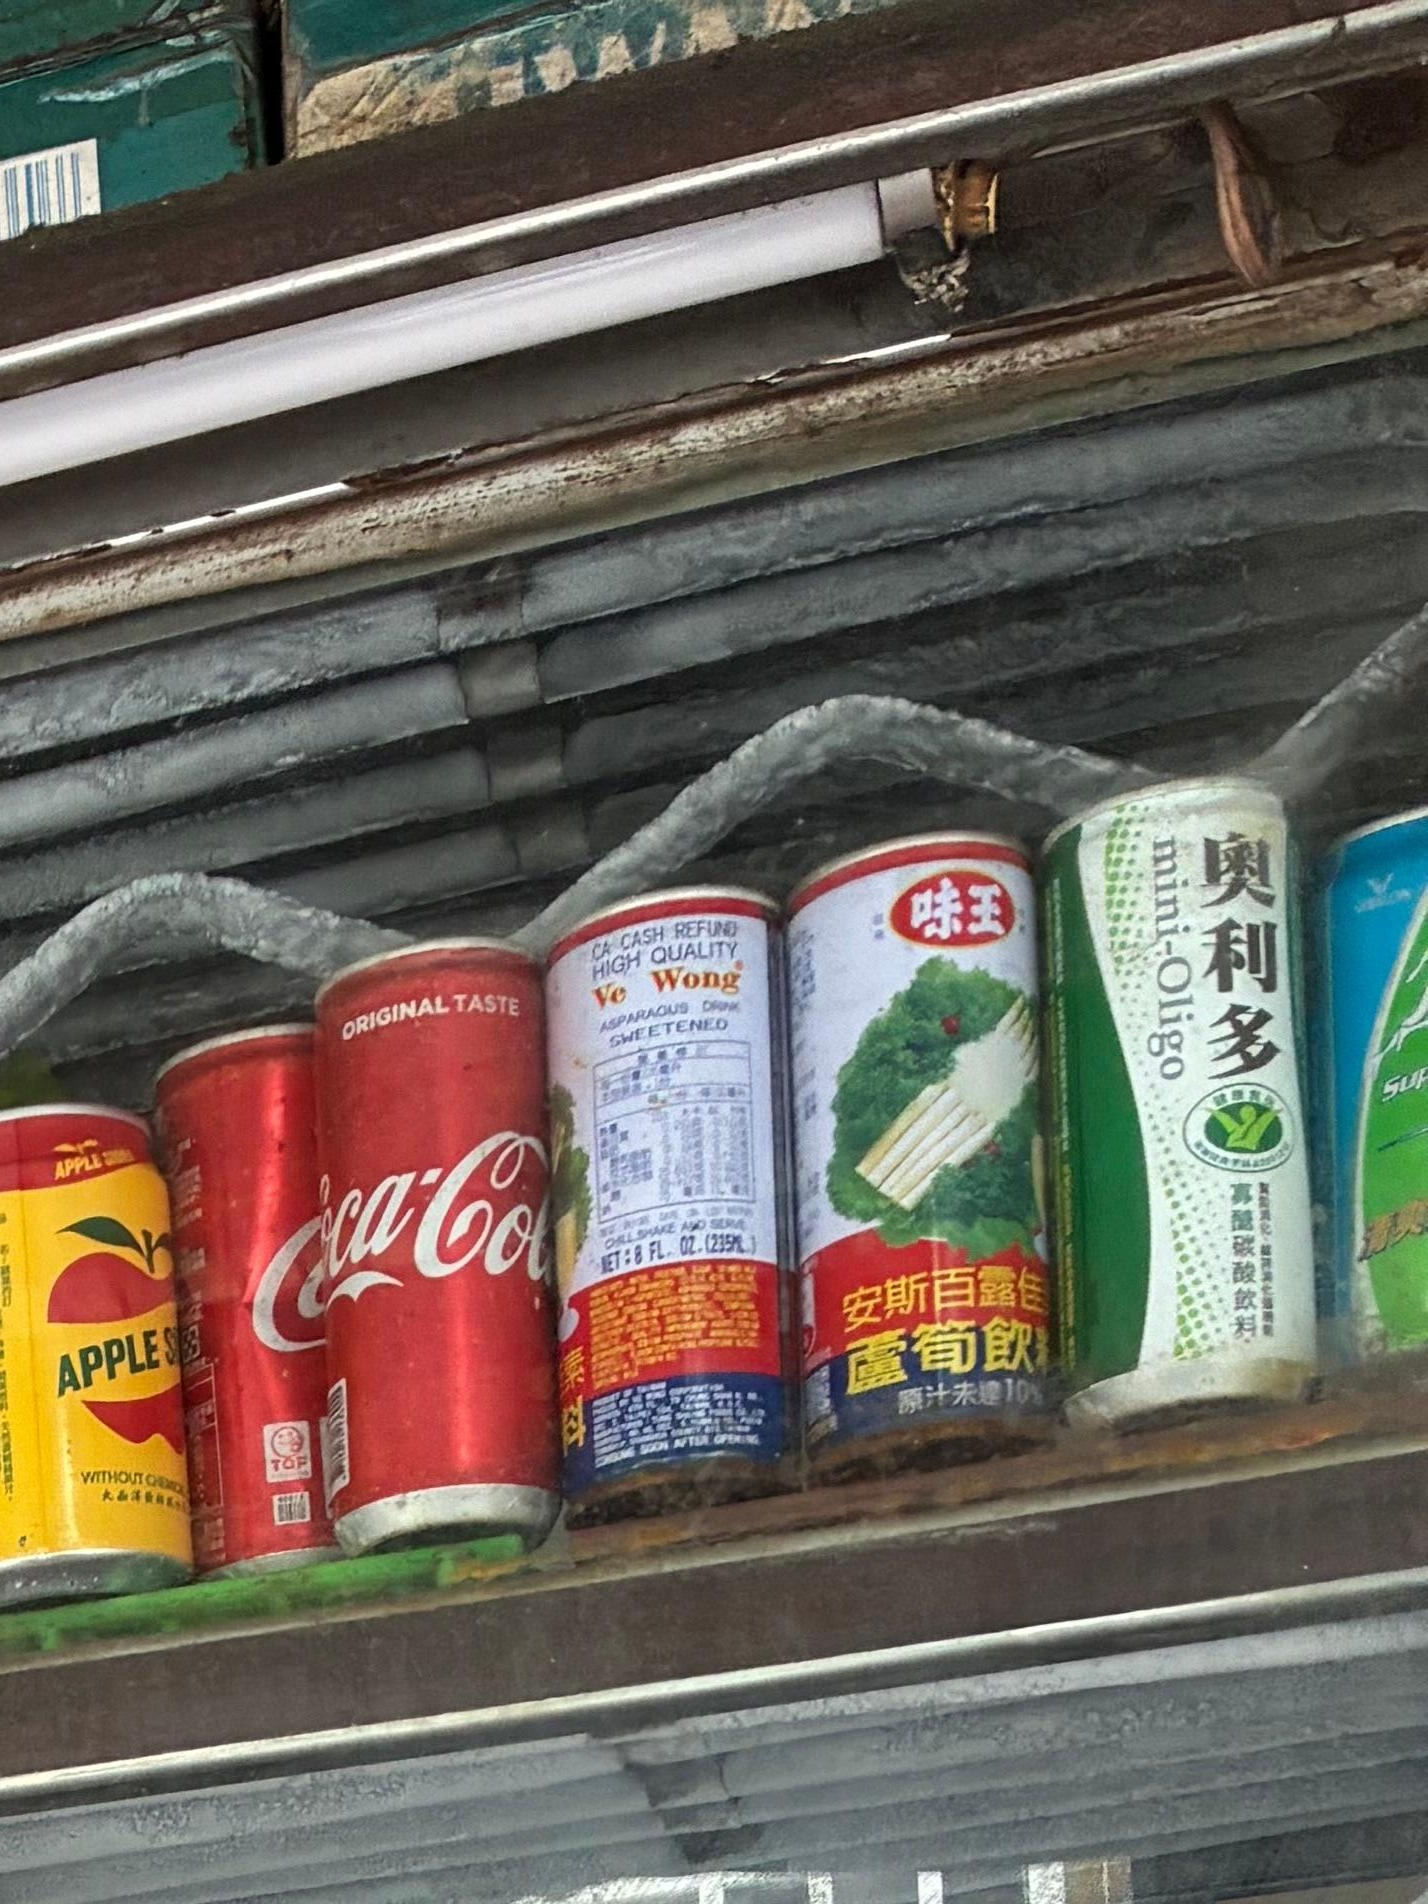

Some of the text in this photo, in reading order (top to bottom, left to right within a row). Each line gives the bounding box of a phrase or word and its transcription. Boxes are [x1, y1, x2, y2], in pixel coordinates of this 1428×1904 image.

[910, 877, 1006, 940] 味王
[621, 926, 664, 950] CASH
[675, 920, 739, 938] REFUND
[593, 941, 738, 980] HIGH QUALITY
[1148, 836, 1194, 1082] mini-Oligo
[1200, 835, 1280, 1080] 奧利多
[592, 966, 742, 1009] Ve Wong
[342, 993, 521, 1041] ORIGINAL TASTE
[599, 1002, 689, 1034] ASPARAGUS
[609, 1018, 729, 1048] SWEETENED
[55, 1154, 102, 1181] APPLE
[57, 1328, 160, 1399] APPLE
[80, 1470, 142, 1486] WITHOUT
